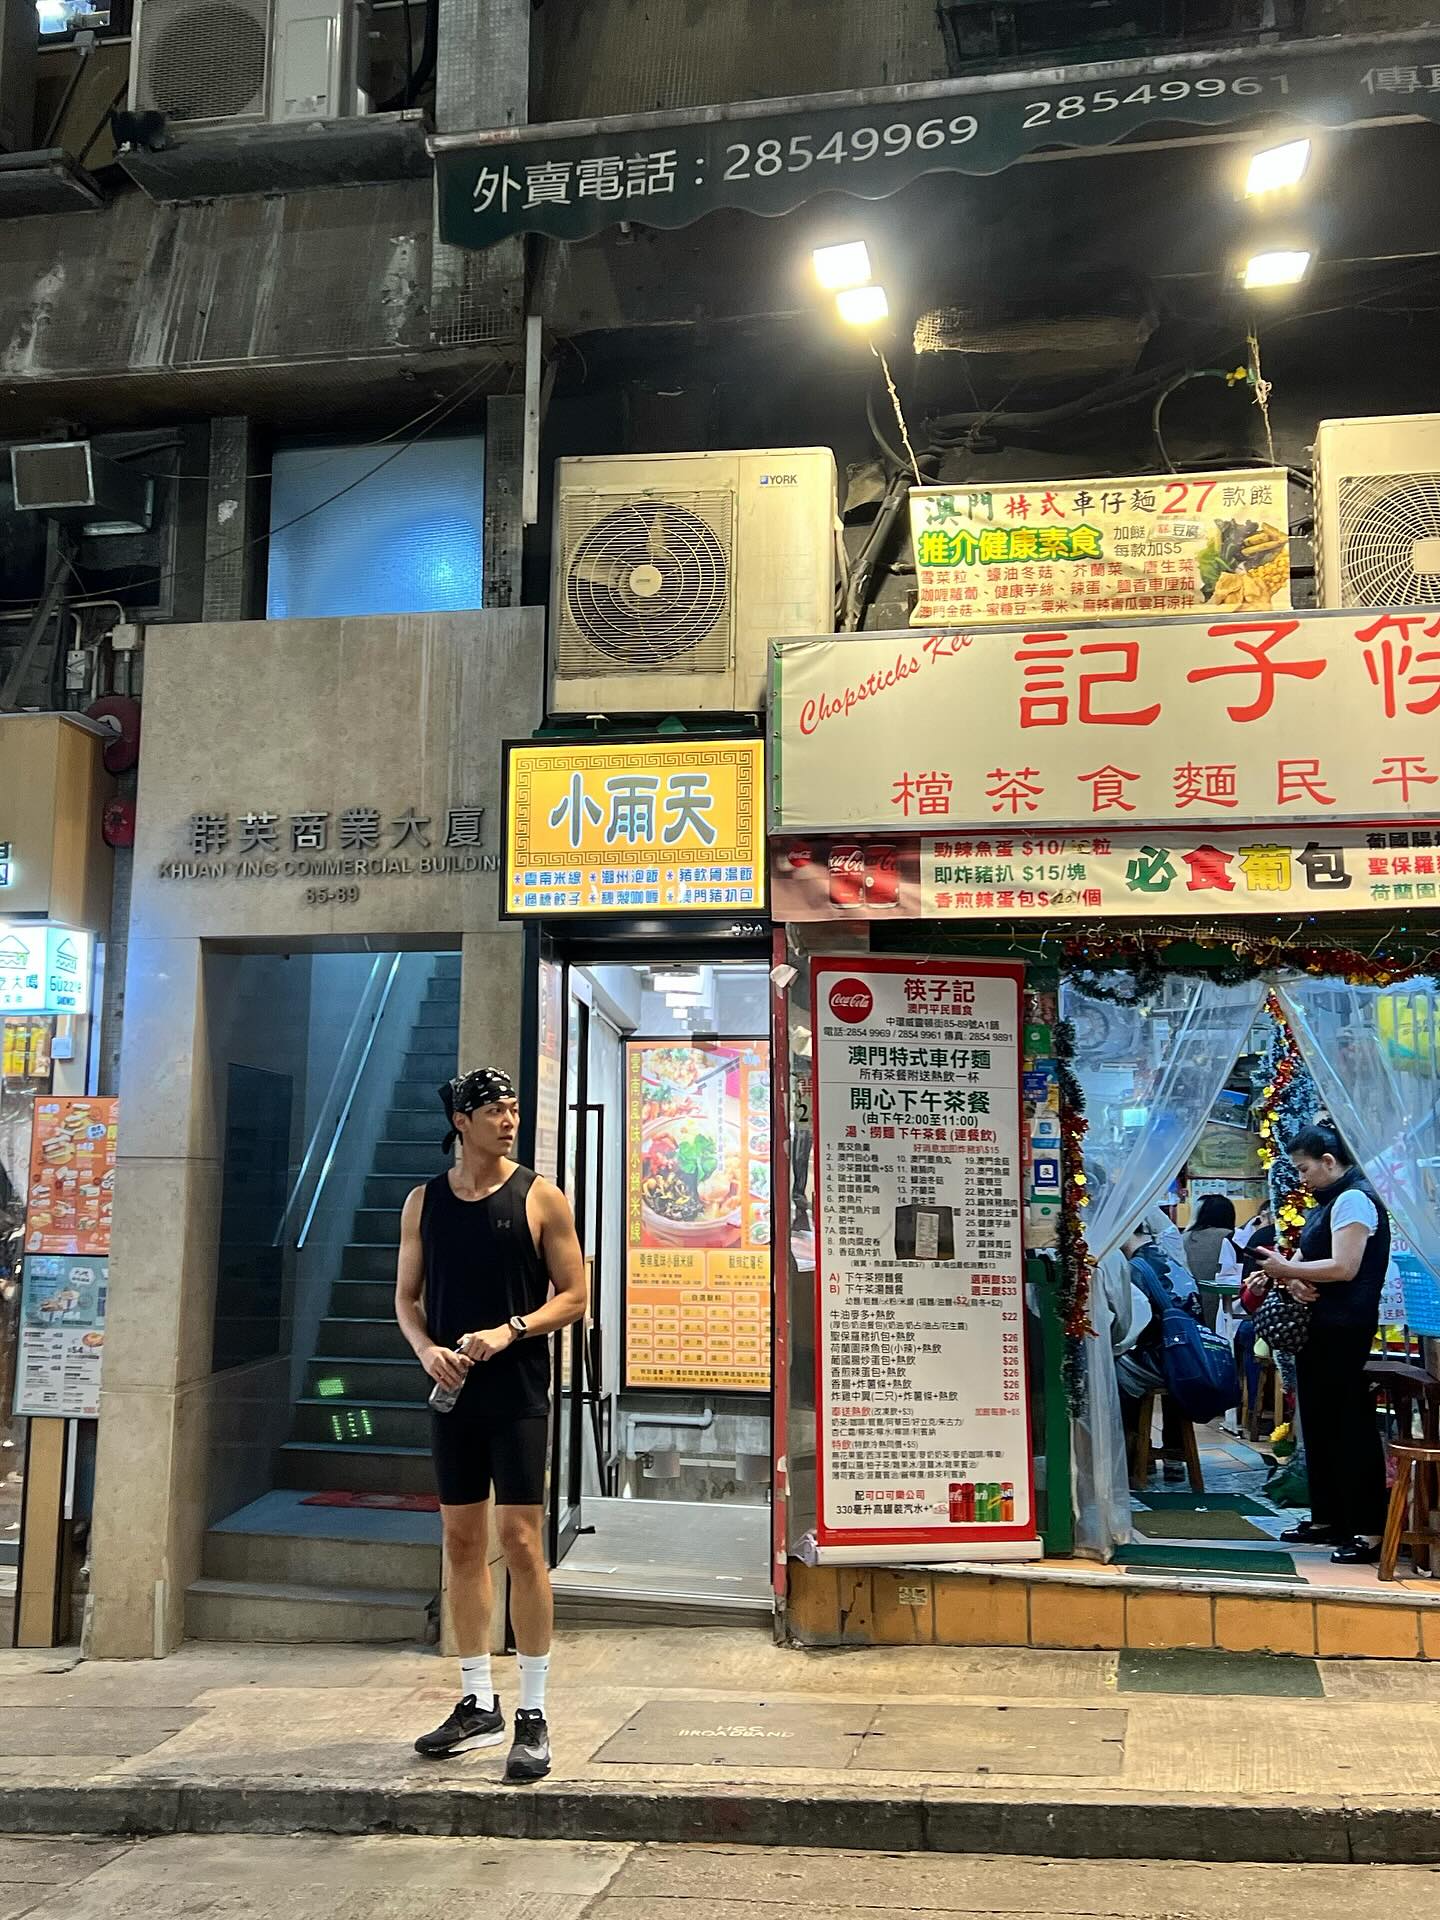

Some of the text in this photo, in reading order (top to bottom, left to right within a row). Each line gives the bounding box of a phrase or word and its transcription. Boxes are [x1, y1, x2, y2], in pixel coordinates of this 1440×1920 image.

[722, 113, 980, 184] 28549969
[1022, 73, 1289, 130] 28549961
[770, 474, 798, 485] YORK
[919, 524, 1104, 566] 推介健康素食
[1114, 541, 1182, 558] 每款加$5
[800, 635, 974, 735] Chopsticks Kee
[548, 772, 718, 848] 小雨天
[933, 841, 1014, 858] 勁辣魚蛋
[1366, 831, 1440, 850] 葡國腸
[158, 860, 226, 881] KHUAN
[234, 859, 279, 878] YING
[284, 857, 411, 877] COMMERCIAL
[934, 863, 1087, 884] 即炸豬扒 $15/塊
[1125, 841, 1353, 893] 必食葡包
[525, 871, 582, 886] 雲南米線
[601, 869, 659, 885] 潮州泡飯
[304, 885, 360, 904] 85-89
[1370, 882, 1440, 902] 荷蘭園
[904, 977, 976, 1003] 筷子記
[907, 1004, 973, 1016] 澳門平民麵食
[869, 1028, 891, 1038] 9969
[898, 1029, 919, 1039] 2854
[920, 1030, 942, 1040] 9961
[969, 1031, 990, 1041] 2854
[848, 1045, 991, 1070] 澳門特式車仔麵
[859, 1068, 980, 1083] 所有茶餐附送熱飲一杯
[850, 1087, 990, 1114] 開心下午茶餐
[862, 1112, 979, 1128] (由下午2:00至11:00)
[900, 1127, 947, 1141] 下午茶餐
[950, 1128, 997, 1142] (連餐飲)
[854, 1489, 926, 1501] 配可口可樂公司
[677, 1729, 796, 1738] BROADBAND
